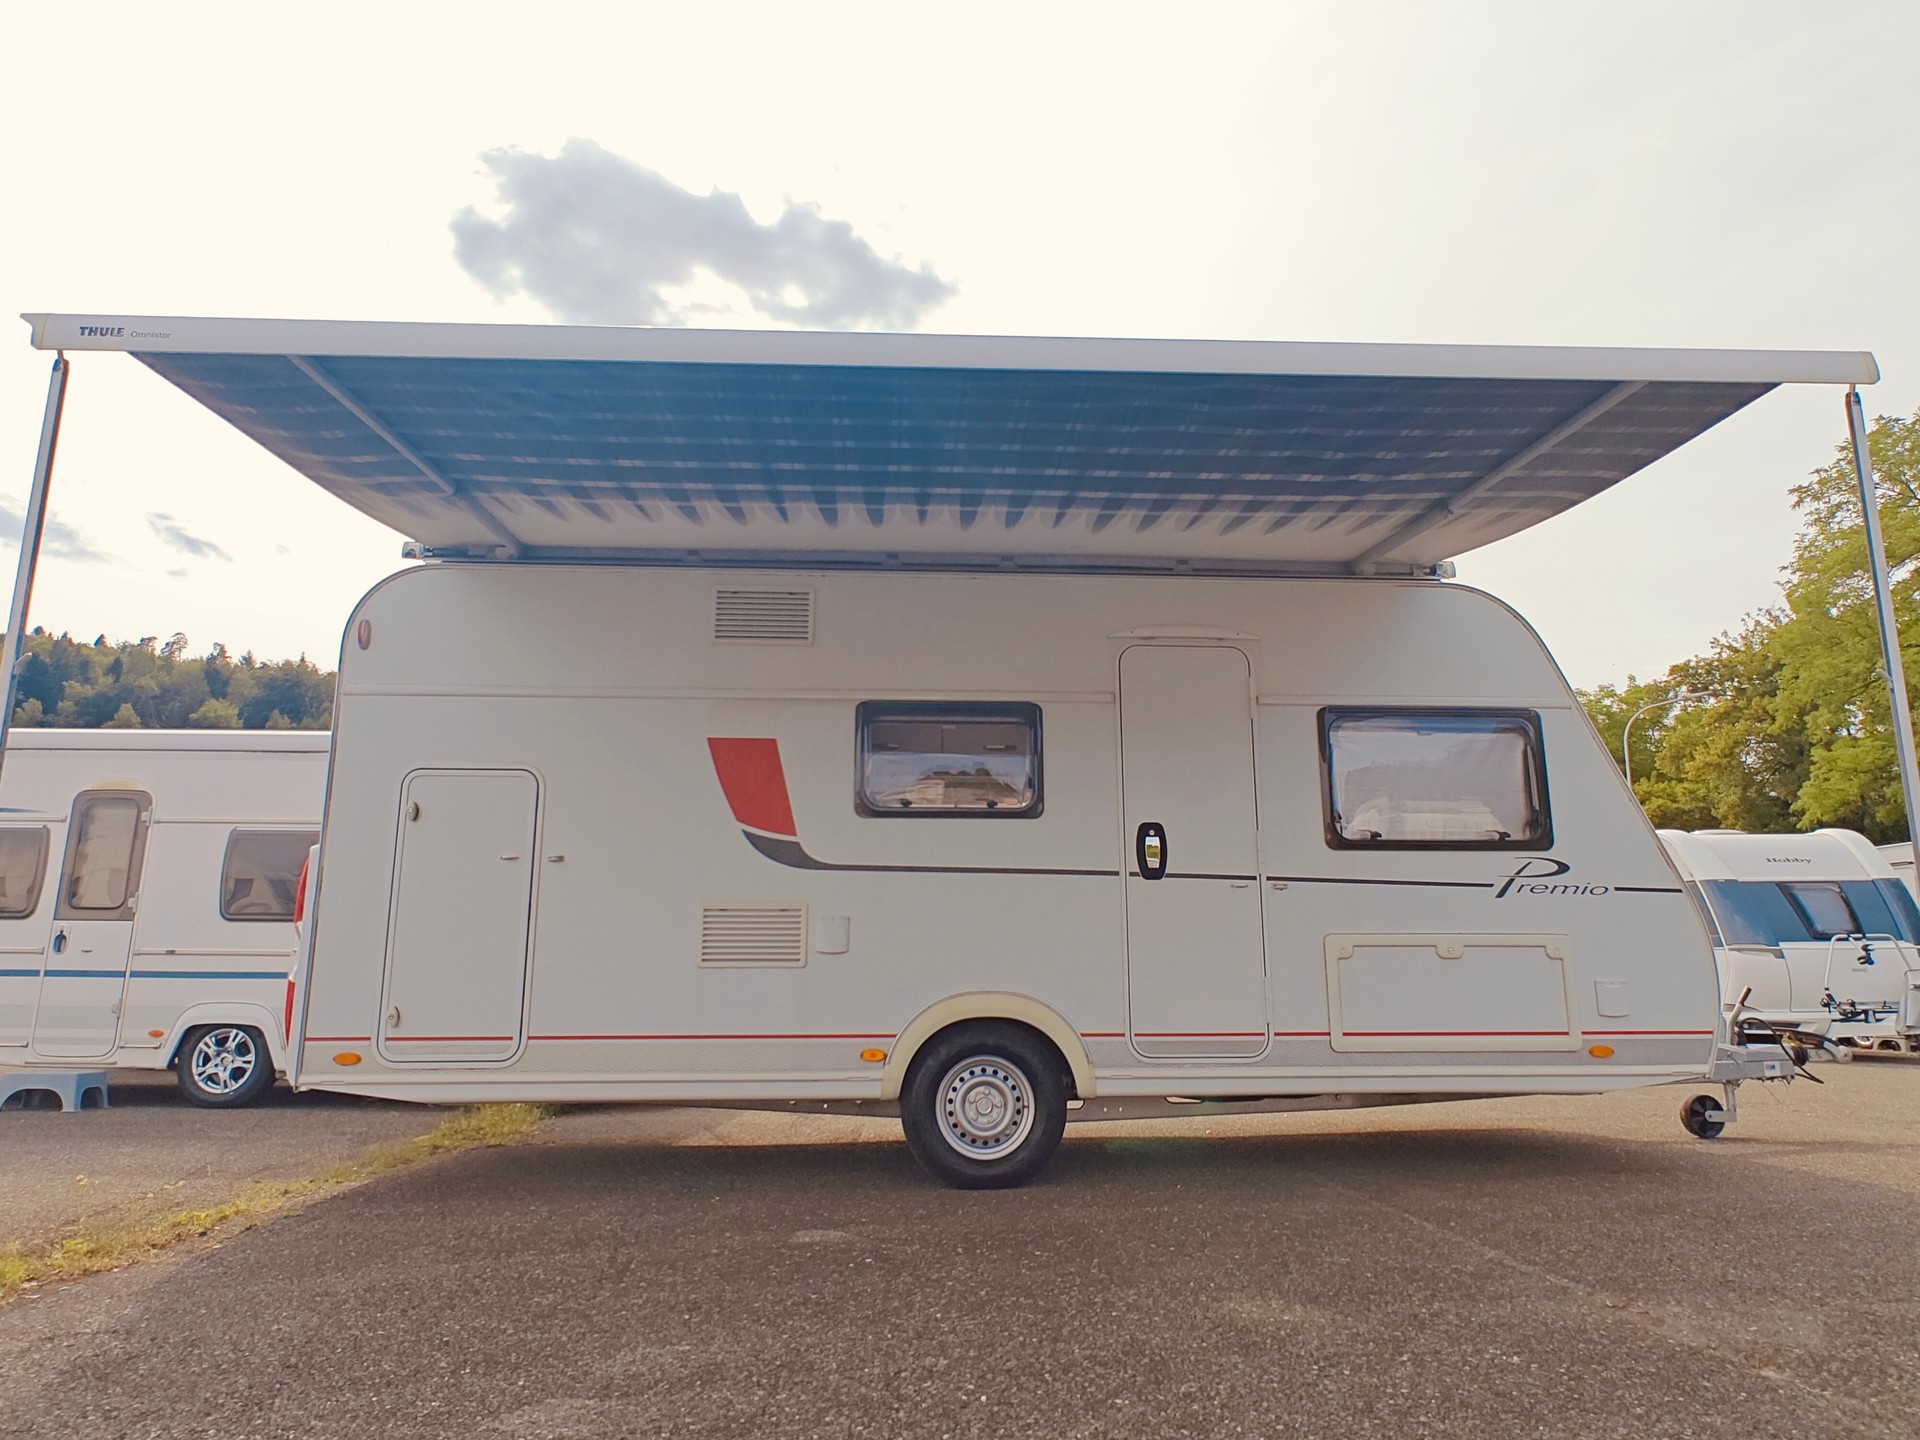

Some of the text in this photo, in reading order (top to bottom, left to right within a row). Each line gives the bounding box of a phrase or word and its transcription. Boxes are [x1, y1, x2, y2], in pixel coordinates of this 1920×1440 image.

[80, 326, 172, 339] THULE Omnistor
[1494, 856, 1609, 898] Premio
